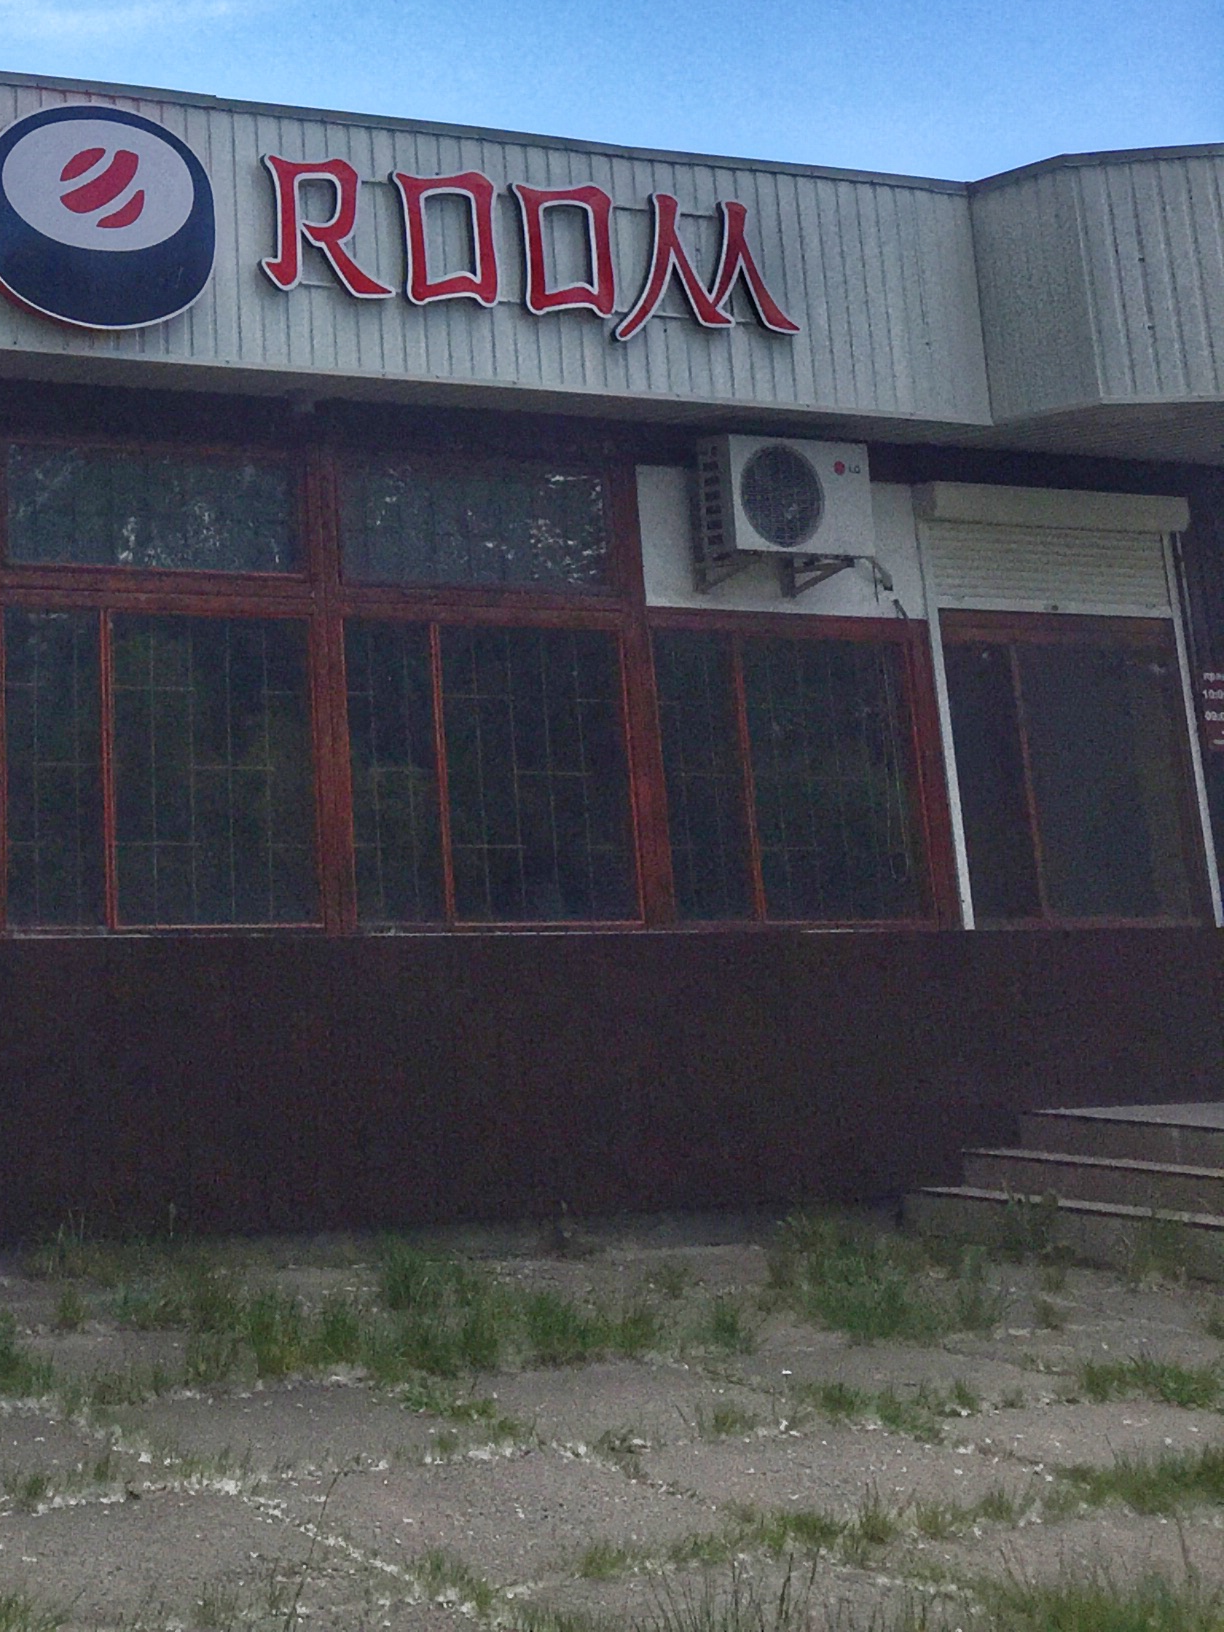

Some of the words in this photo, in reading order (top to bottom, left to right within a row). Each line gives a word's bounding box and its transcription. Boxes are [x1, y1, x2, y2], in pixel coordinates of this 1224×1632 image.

[259, 152, 800, 342] ROOM
[848, 464, 861, 474] LG
[1202, 689, 1224, 700] 10:0
